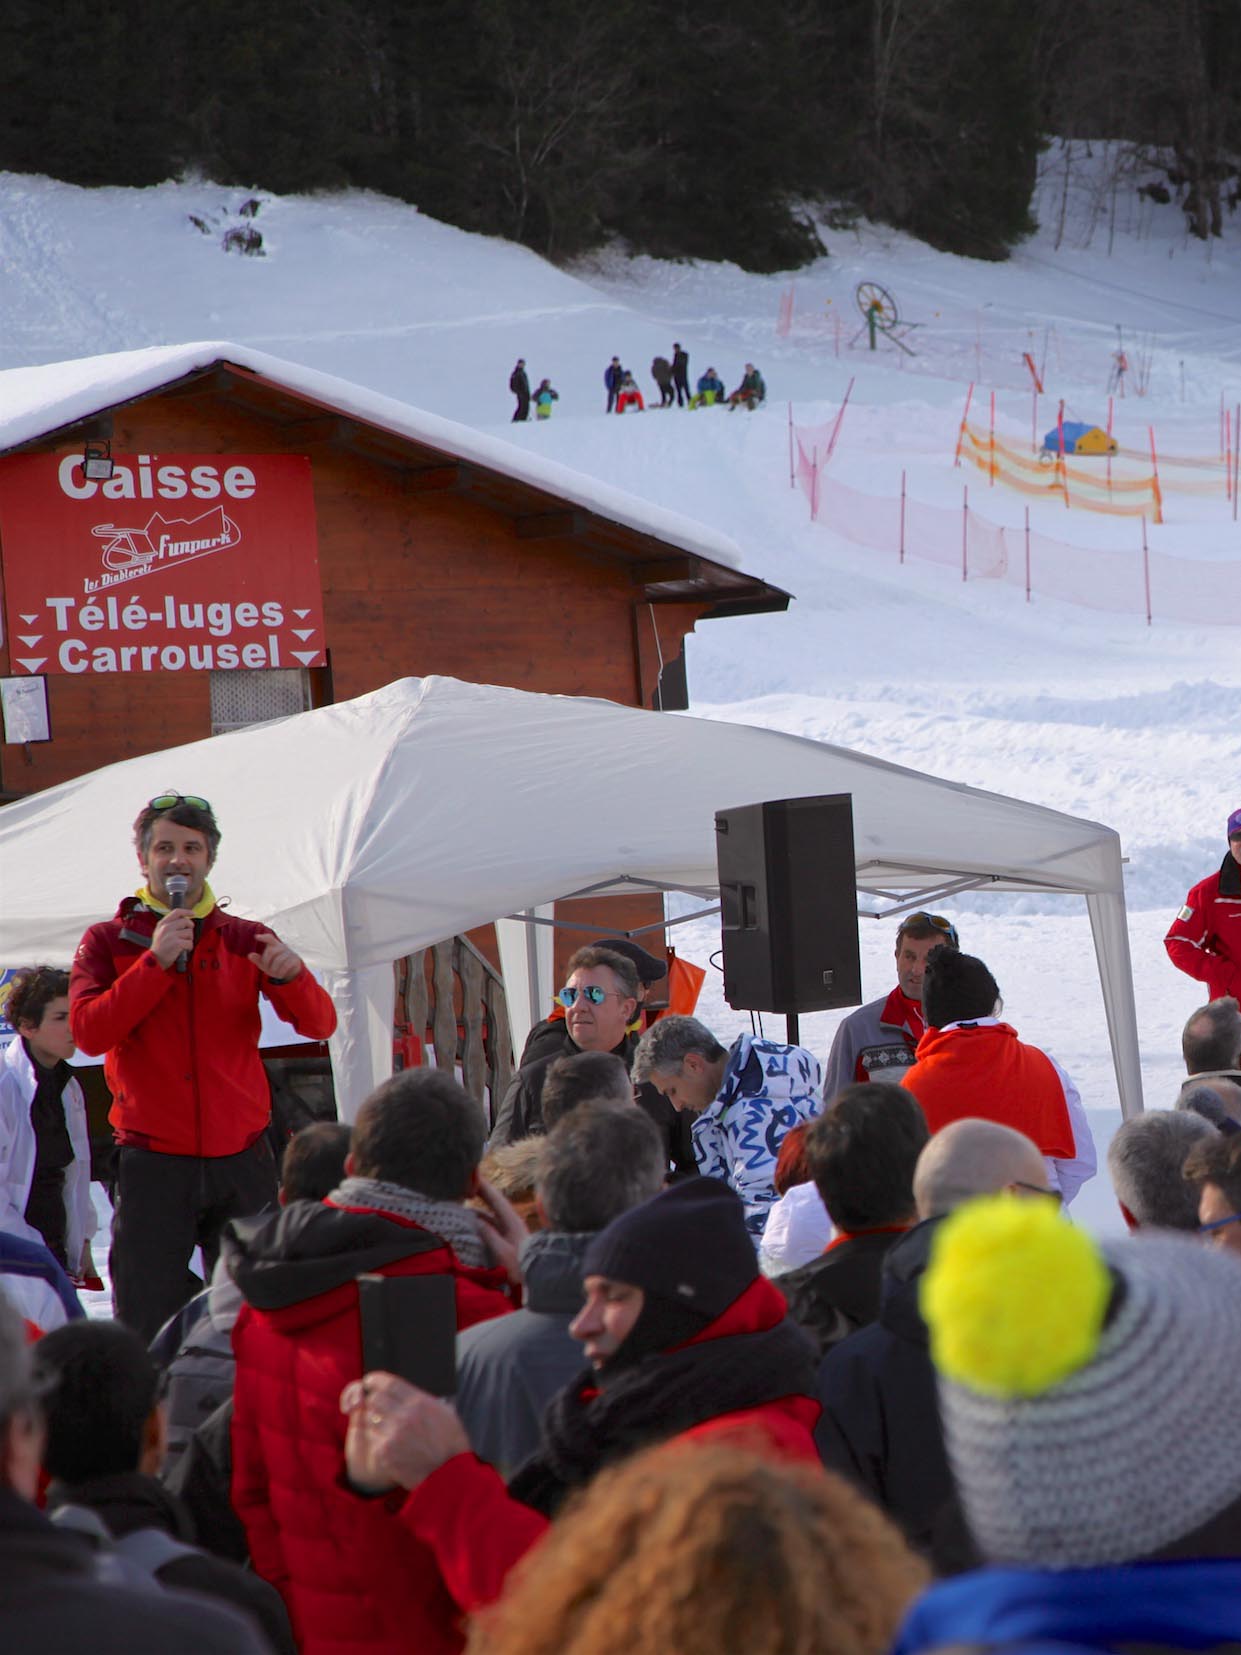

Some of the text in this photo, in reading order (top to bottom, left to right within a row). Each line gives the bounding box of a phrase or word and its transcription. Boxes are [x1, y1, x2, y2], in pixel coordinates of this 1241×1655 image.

[58, 454, 257, 500] Caisse
[101, 564, 153, 587] Diablerets
[46, 595, 285, 637] Télé-luges
[58, 634, 280, 674] Carrousel
